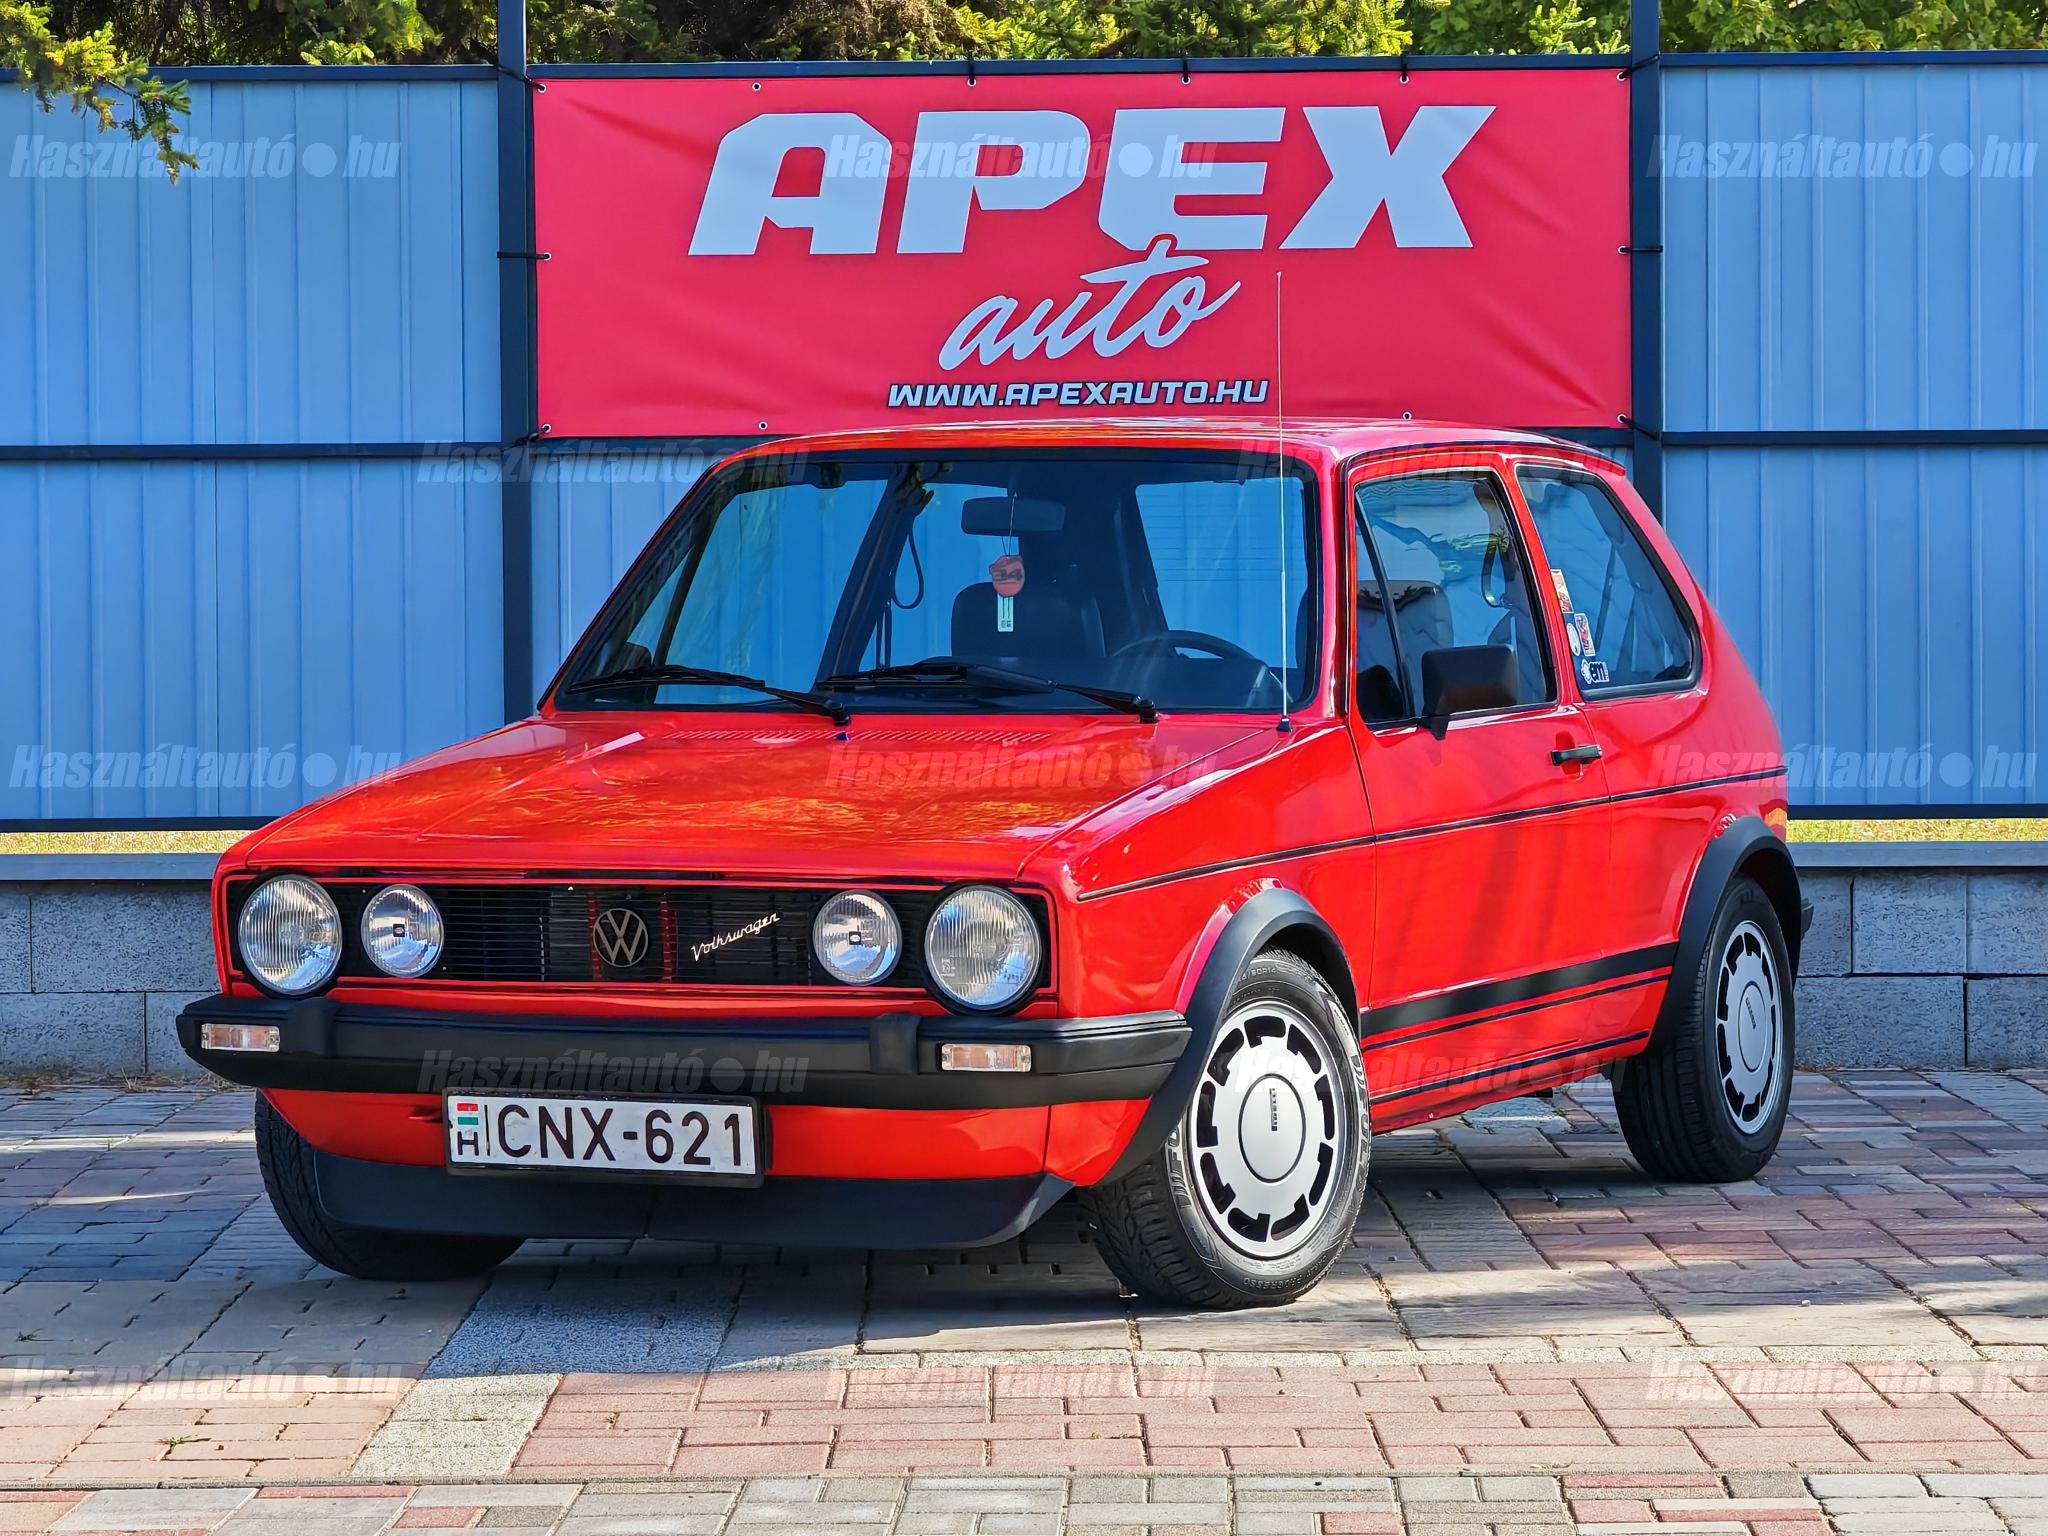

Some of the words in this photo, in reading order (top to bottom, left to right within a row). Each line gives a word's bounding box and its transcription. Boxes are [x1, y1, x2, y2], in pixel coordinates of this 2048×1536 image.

[689, 106, 1496, 255] APEX
[938, 234, 1241, 370] auto
[887, 380, 1270, 407] WWW.APEXAUTO.HU
[691, 911, 781, 963] Volkswagen
[457, 1131, 479, 1156] H
[497, 1104, 742, 1166] CNX-621
